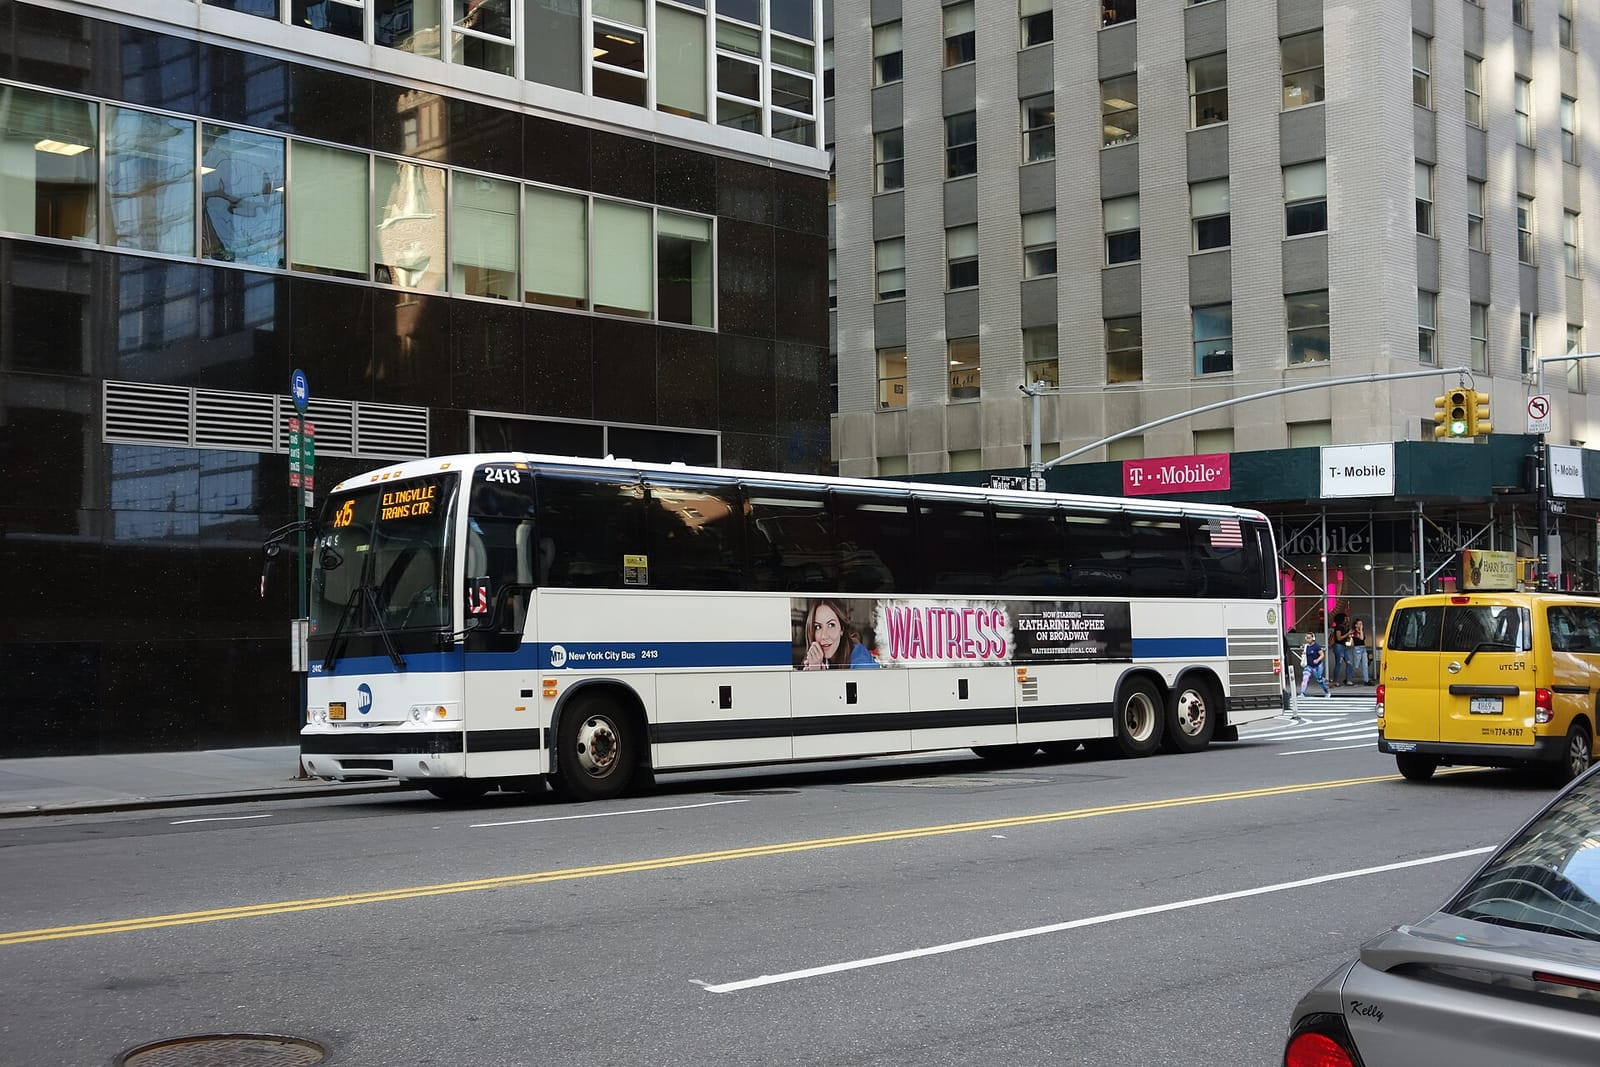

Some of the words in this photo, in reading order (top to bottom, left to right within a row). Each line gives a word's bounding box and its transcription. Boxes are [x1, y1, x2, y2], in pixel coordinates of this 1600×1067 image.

[484, 466, 521, 484] 2413
[381, 505, 411, 520] TRANS
[1042, 611, 1056, 619] NOW
[1018, 620, 1070, 631] KATHARINE
[1072, 620, 1105, 631] McPHEE
[885, 606, 1007, 660] WAITRESS
[1036, 631, 1048, 641] ON
[1049, 631, 1090, 641] BROADWAY
[568, 651, 586, 661] New
[586, 651, 602, 660] York
[604, 650, 620, 662] City
[621, 650, 636, 660] Bus
[641, 650, 658, 659] 2413
[1350, 1000, 1385, 1023] Kelly
